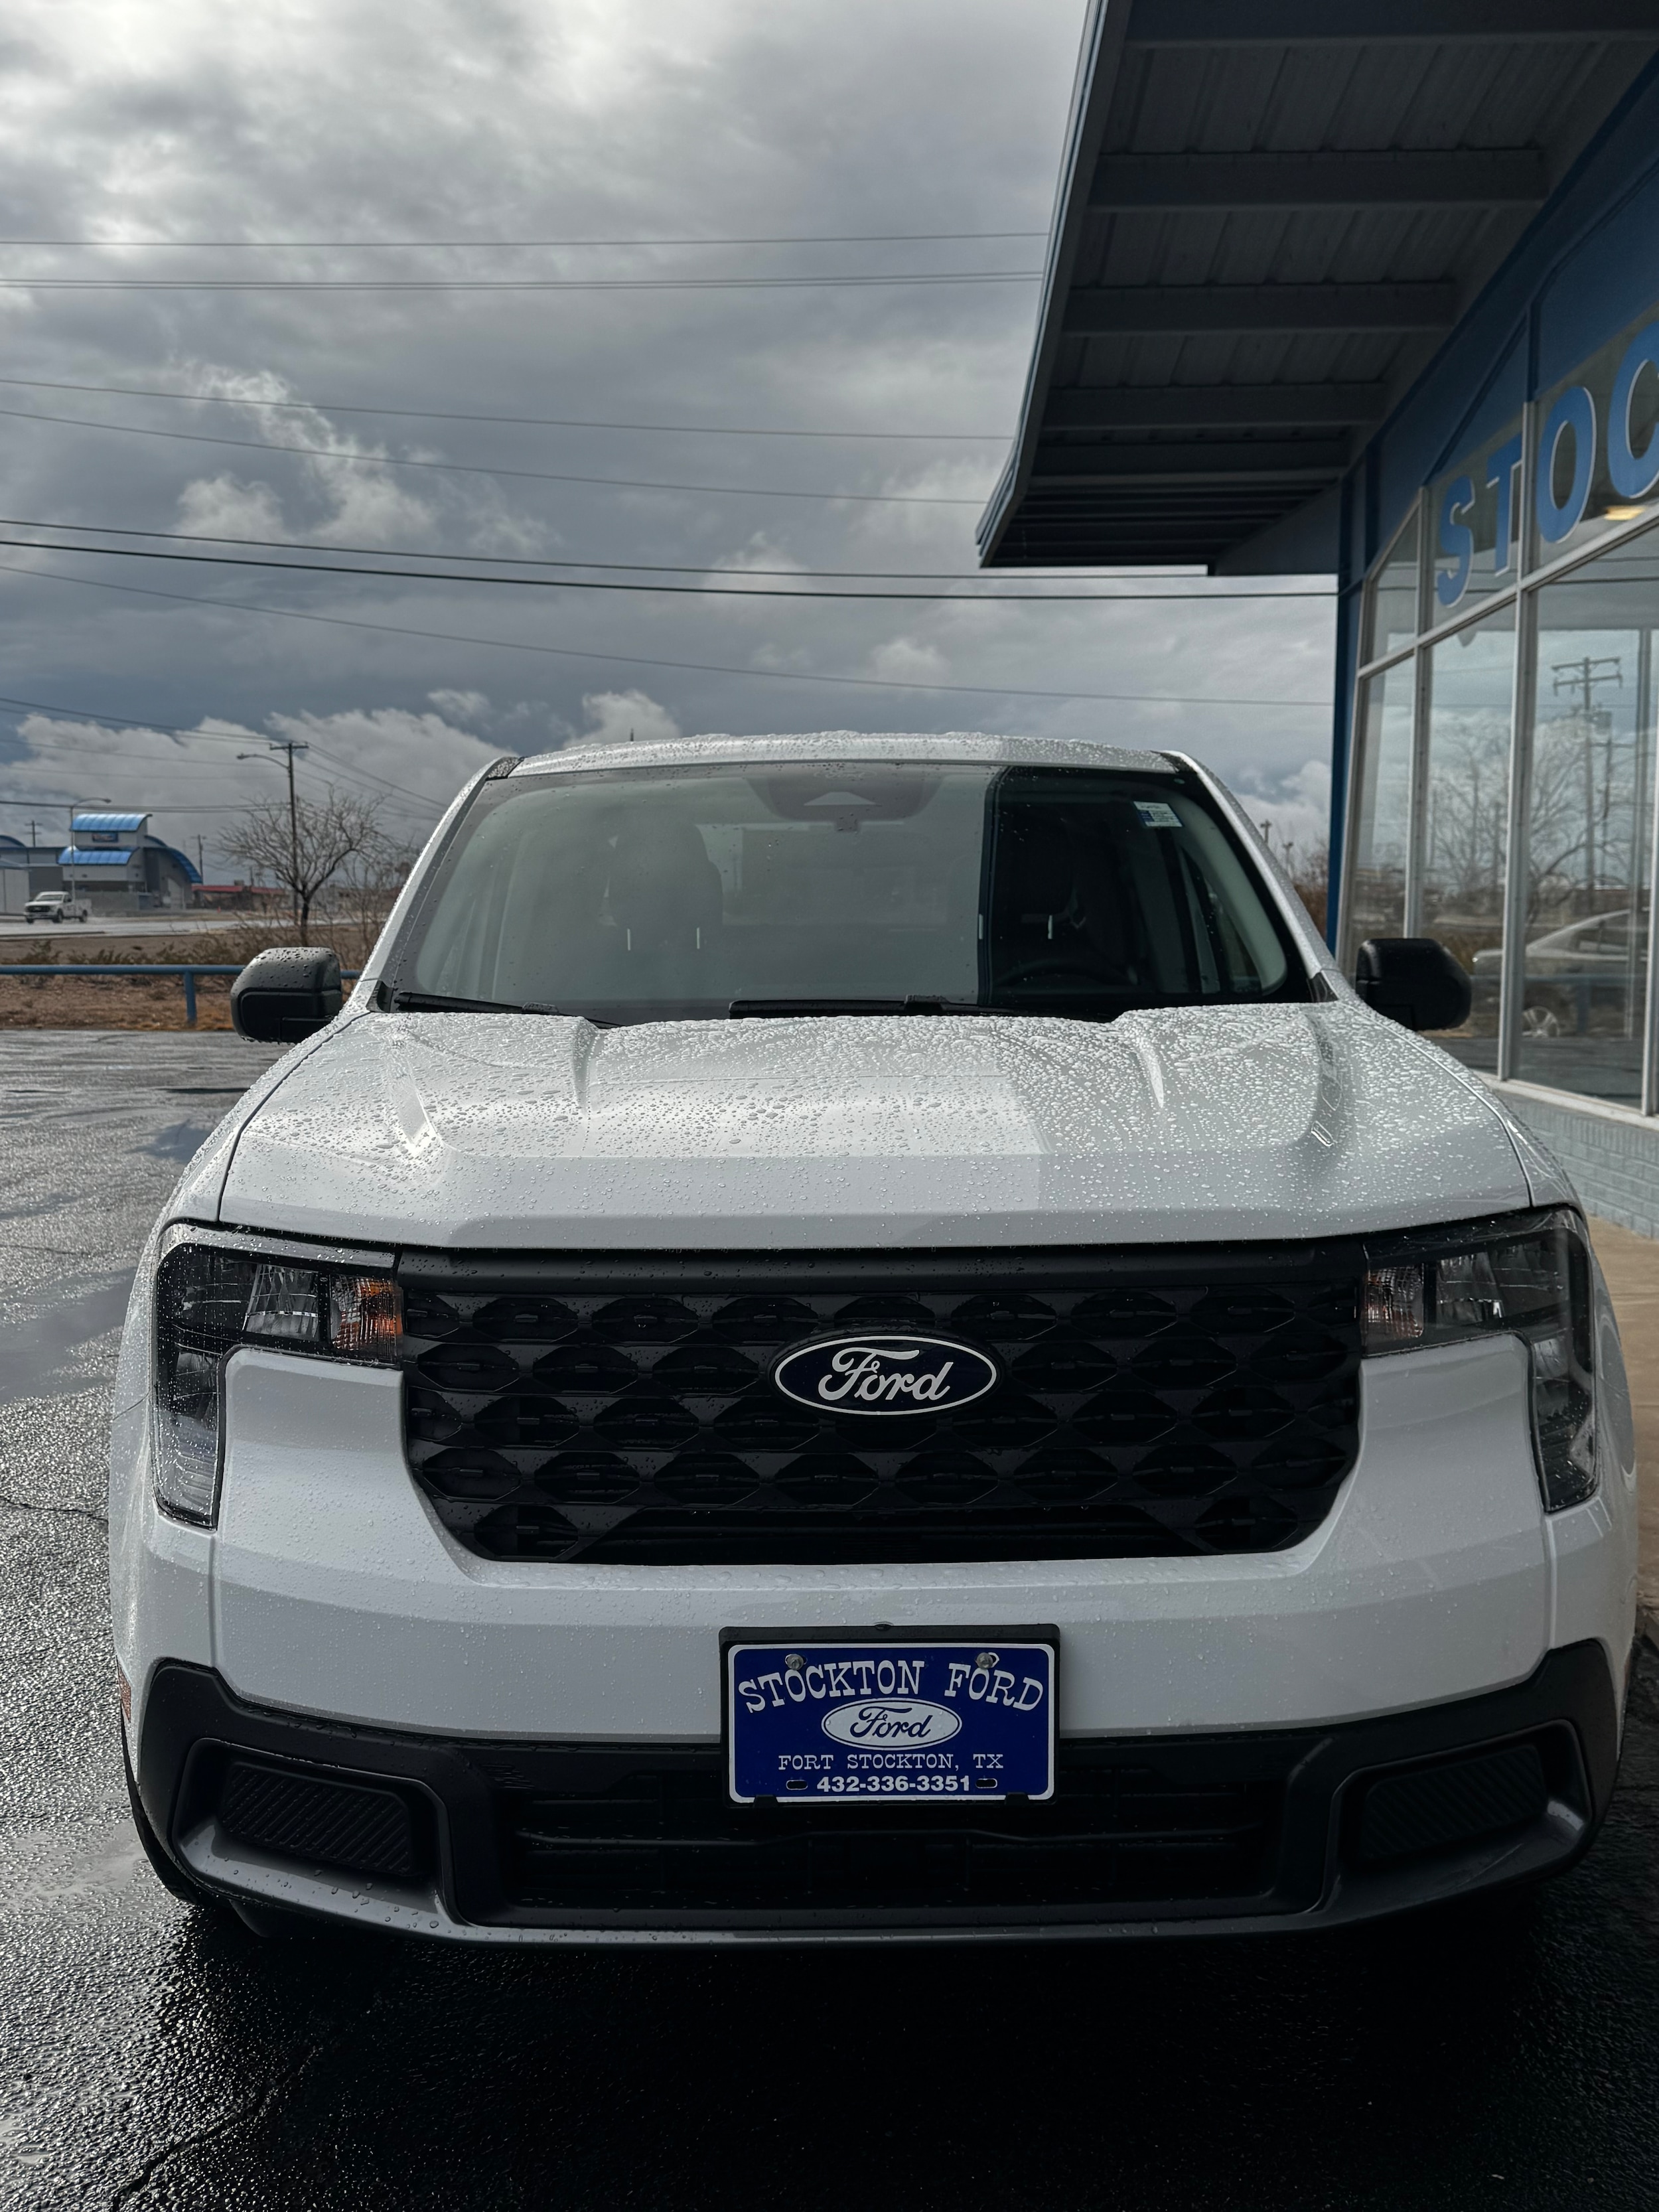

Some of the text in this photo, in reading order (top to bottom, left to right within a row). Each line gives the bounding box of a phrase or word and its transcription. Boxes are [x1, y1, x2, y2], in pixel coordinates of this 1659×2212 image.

[1437, 320, 1659, 608] STOC
[818, 1347, 954, 1400] Ford
[739, 1660, 1044, 1713] STOCKTON FORD
[849, 1706, 933, 1737] Ford
[778, 1753, 1004, 1771] FORT STOCKTON, TX
[816, 1775, 970, 1793] 432-336-3351
